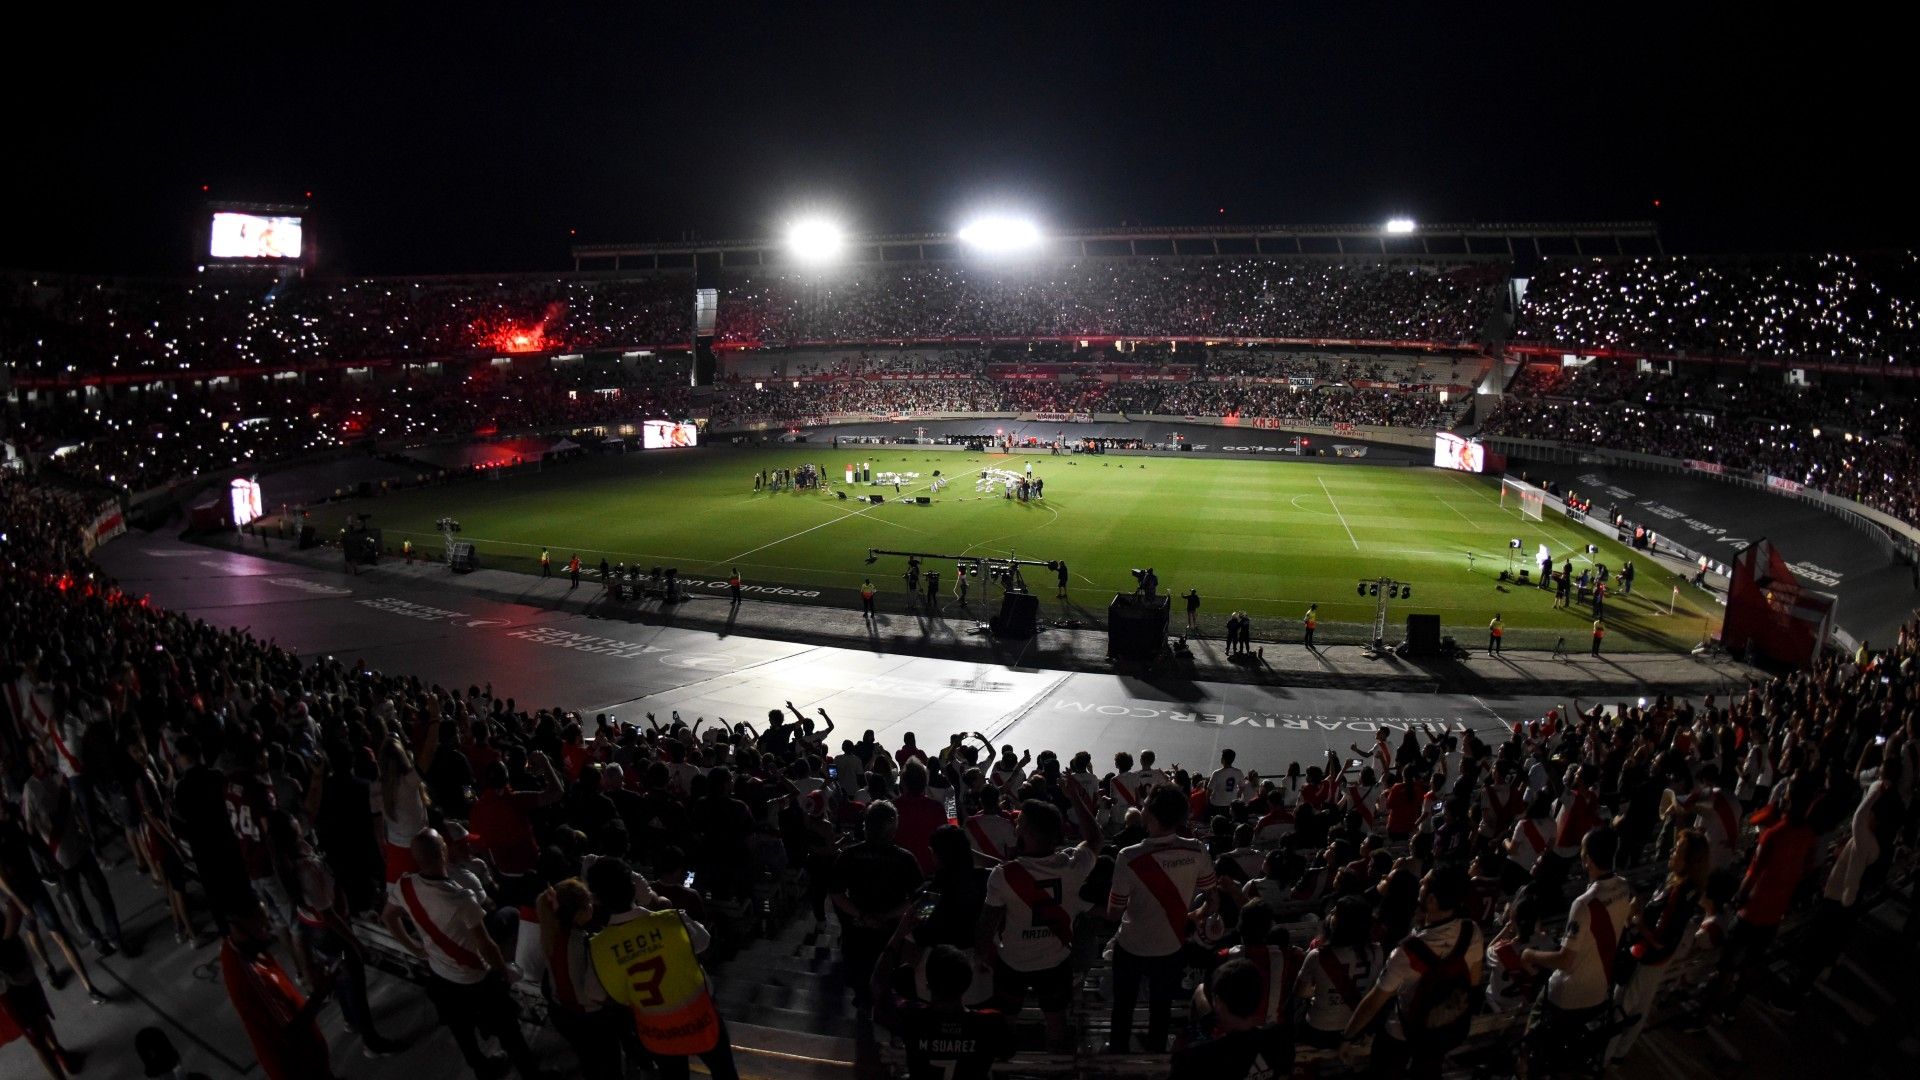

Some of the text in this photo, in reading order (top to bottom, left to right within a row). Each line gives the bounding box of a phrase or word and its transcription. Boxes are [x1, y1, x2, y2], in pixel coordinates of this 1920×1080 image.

[1252, 417, 1266, 428] KM
[1268, 418, 1280, 429] 30
[1333, 422, 1355, 431] CHUPE
[506, 631, 642, 659] TURKISH
[530, 627, 672, 653] AIRLINES
[1226, 777, 1235, 792] 9
[1162, 856, 1195, 868] Francés
[1032, 878, 1062, 926] 2
[610, 928, 663, 958] TECH
[627, 956, 666, 1008] 3
[919, 1039, 977, 1053] M SUAREZ
